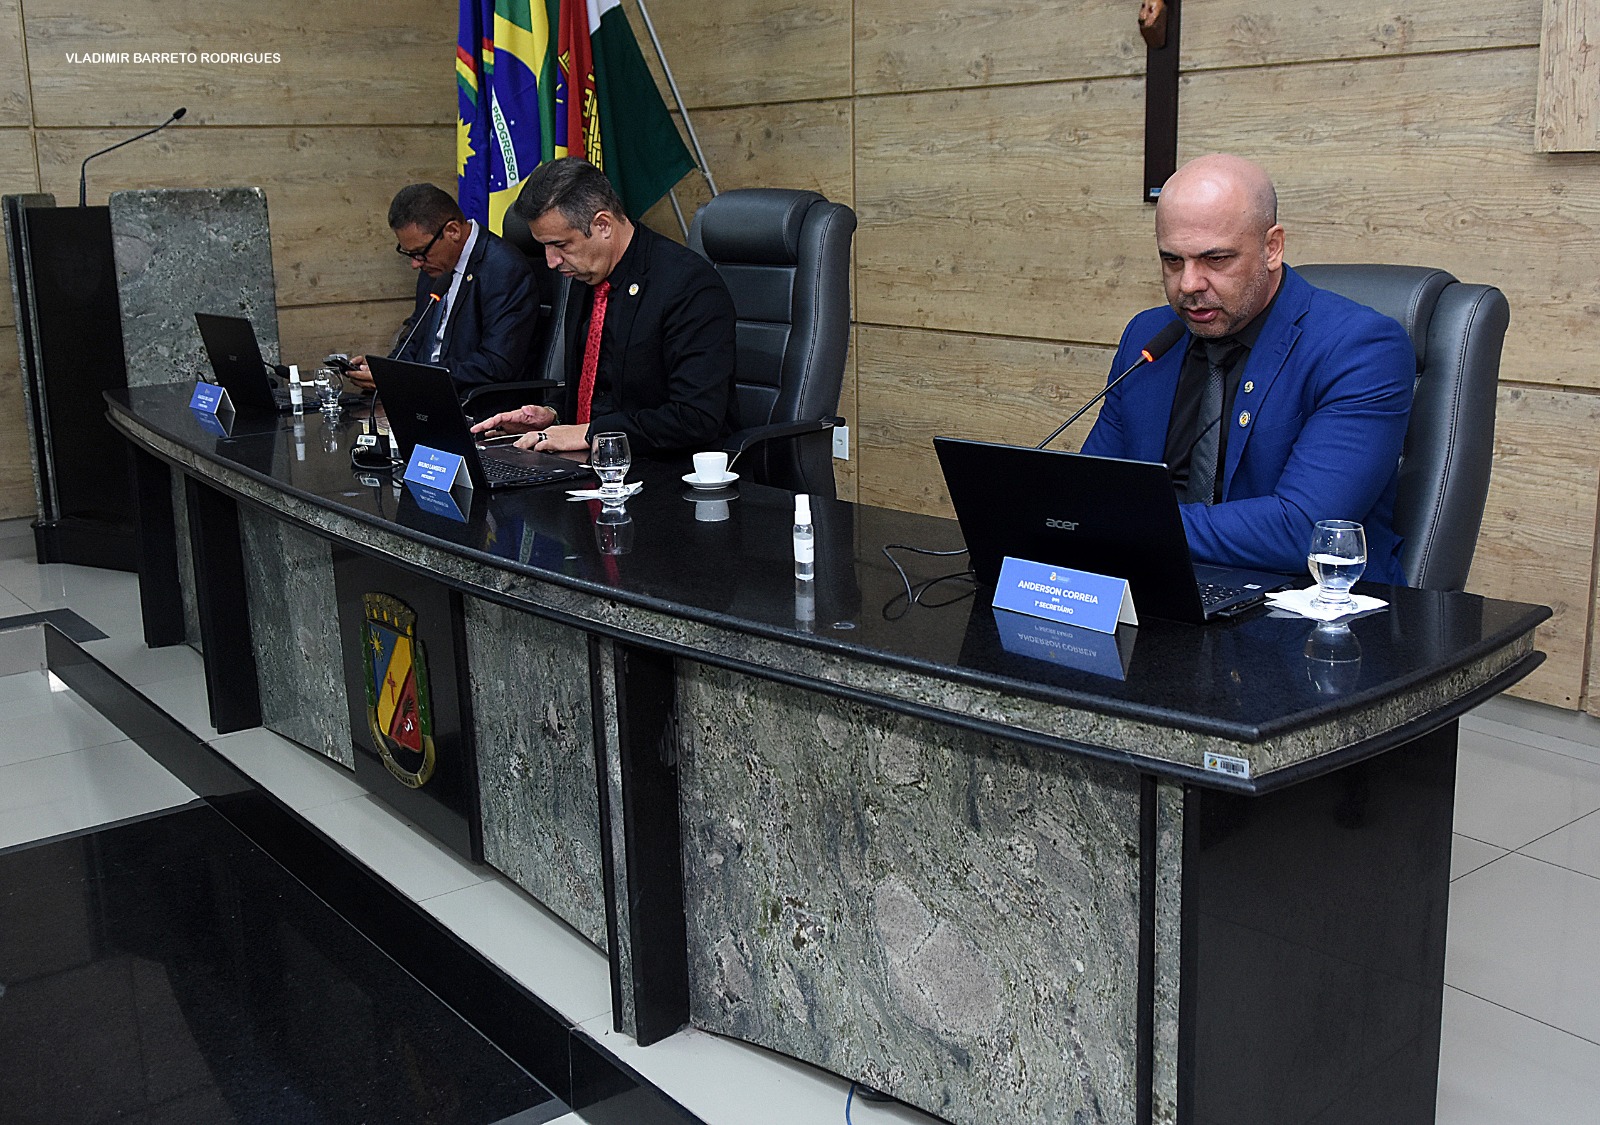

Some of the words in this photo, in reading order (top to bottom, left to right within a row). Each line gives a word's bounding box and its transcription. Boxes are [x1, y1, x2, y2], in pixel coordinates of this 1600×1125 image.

[492, 106, 517, 181] PROGRESSO
[1045, 518, 1079, 531] acer
[1018, 580, 1062, 596] ANDERSON
[1062, 589, 1099, 604] CORREIA
[1039, 601, 1074, 615] SECRETÁRIO
